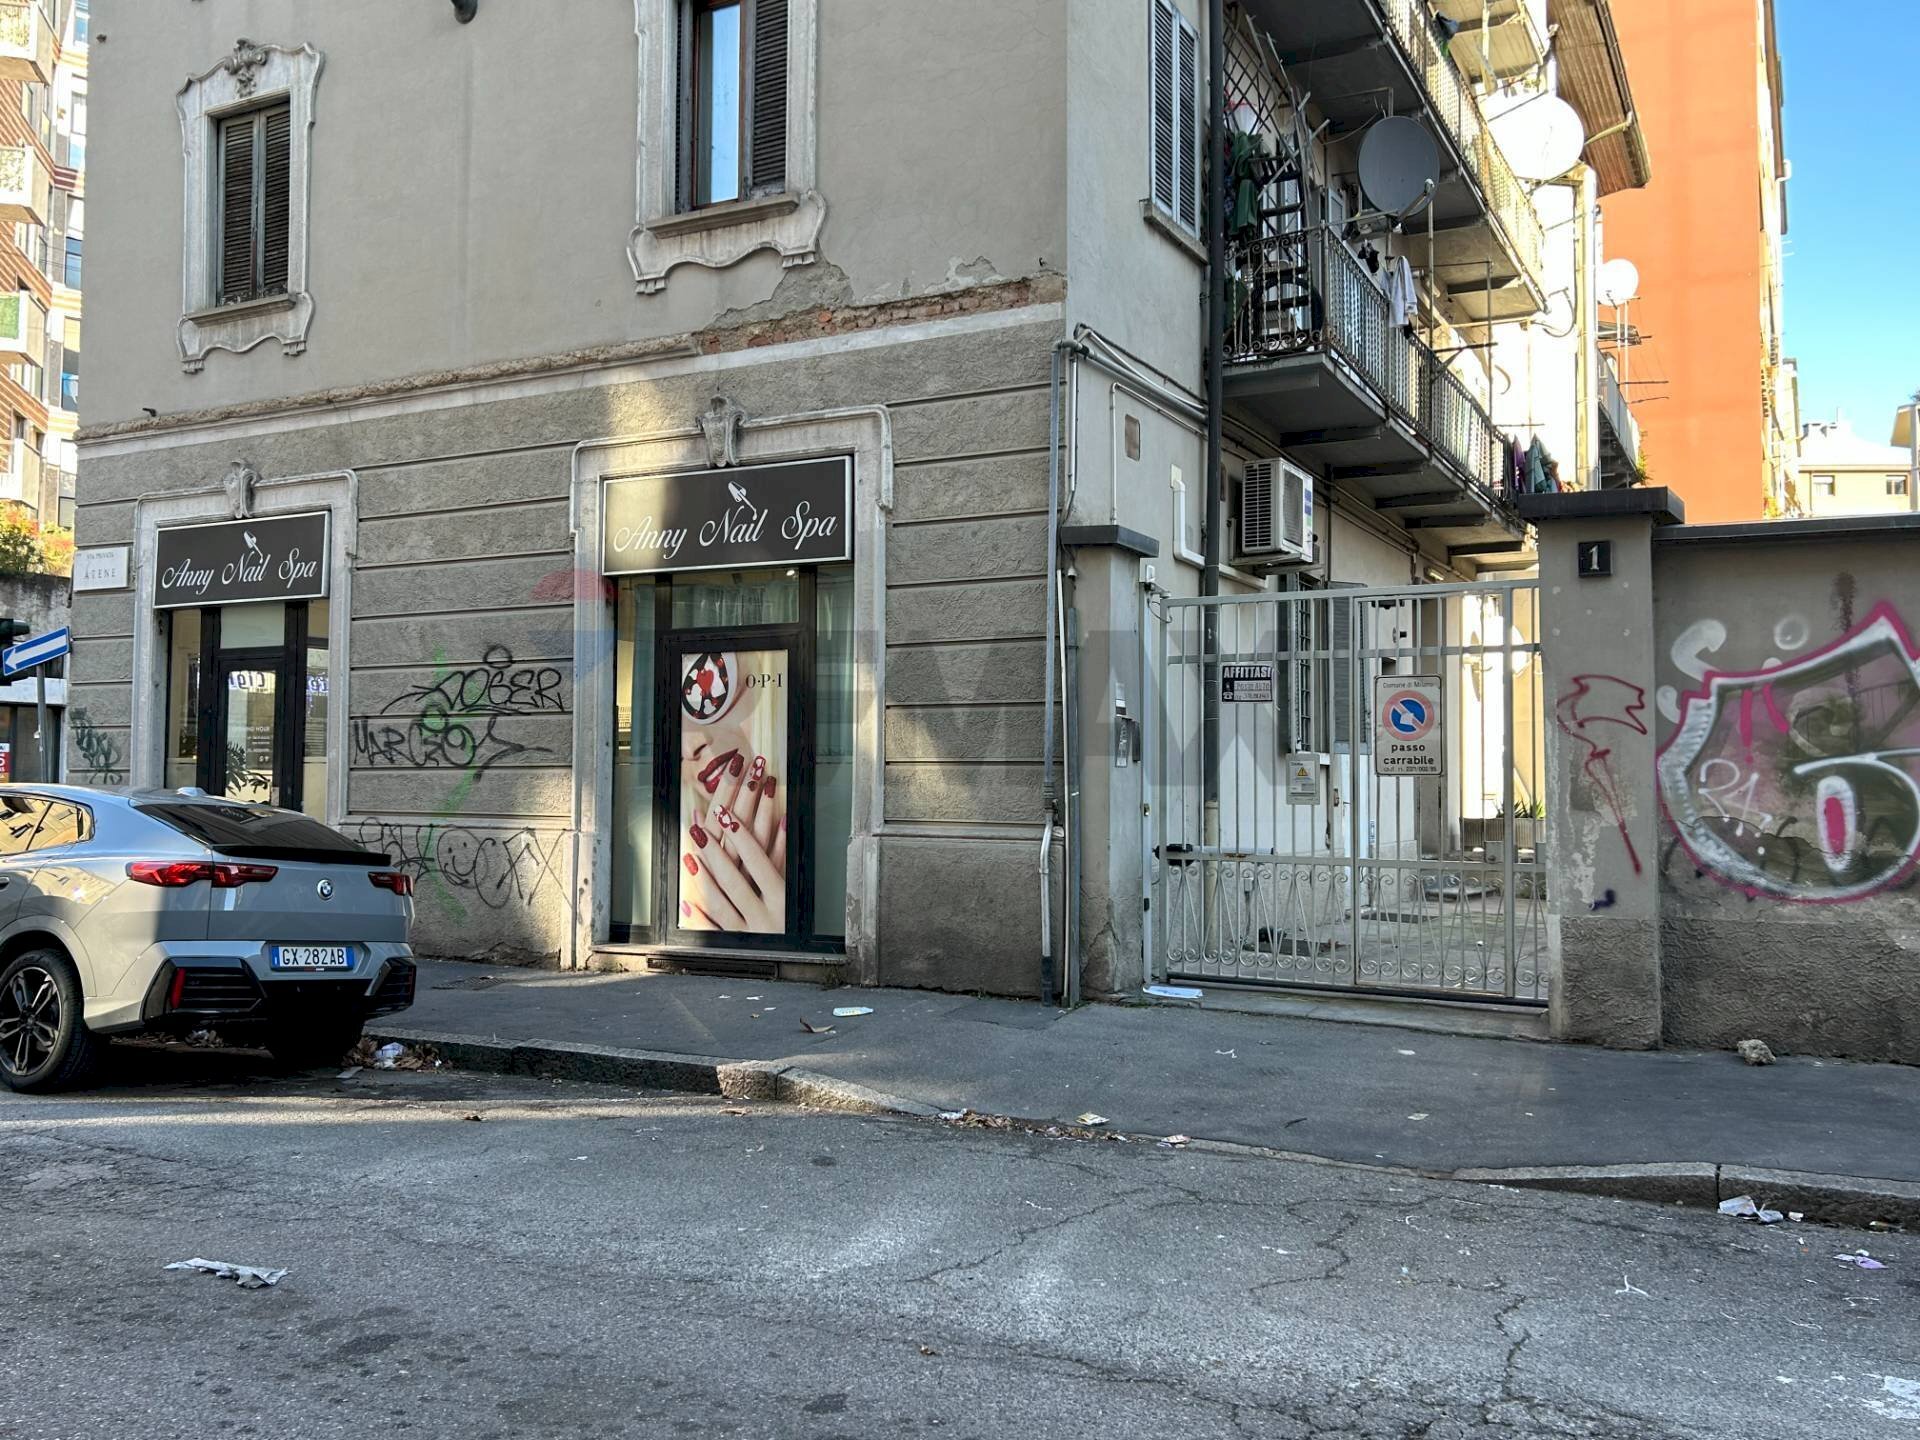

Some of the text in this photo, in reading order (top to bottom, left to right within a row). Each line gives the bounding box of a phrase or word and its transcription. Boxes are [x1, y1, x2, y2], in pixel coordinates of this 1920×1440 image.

[613, 501, 838, 560] Anny Nail Spa
[1588, 544, 1600, 570] 1
[162, 547, 318, 595] Anny Nail Spa
[1223, 666, 1271, 679] AFFITTASI
[1391, 744, 1425, 753] passo
[1383, 755, 1434, 765] carrabile
